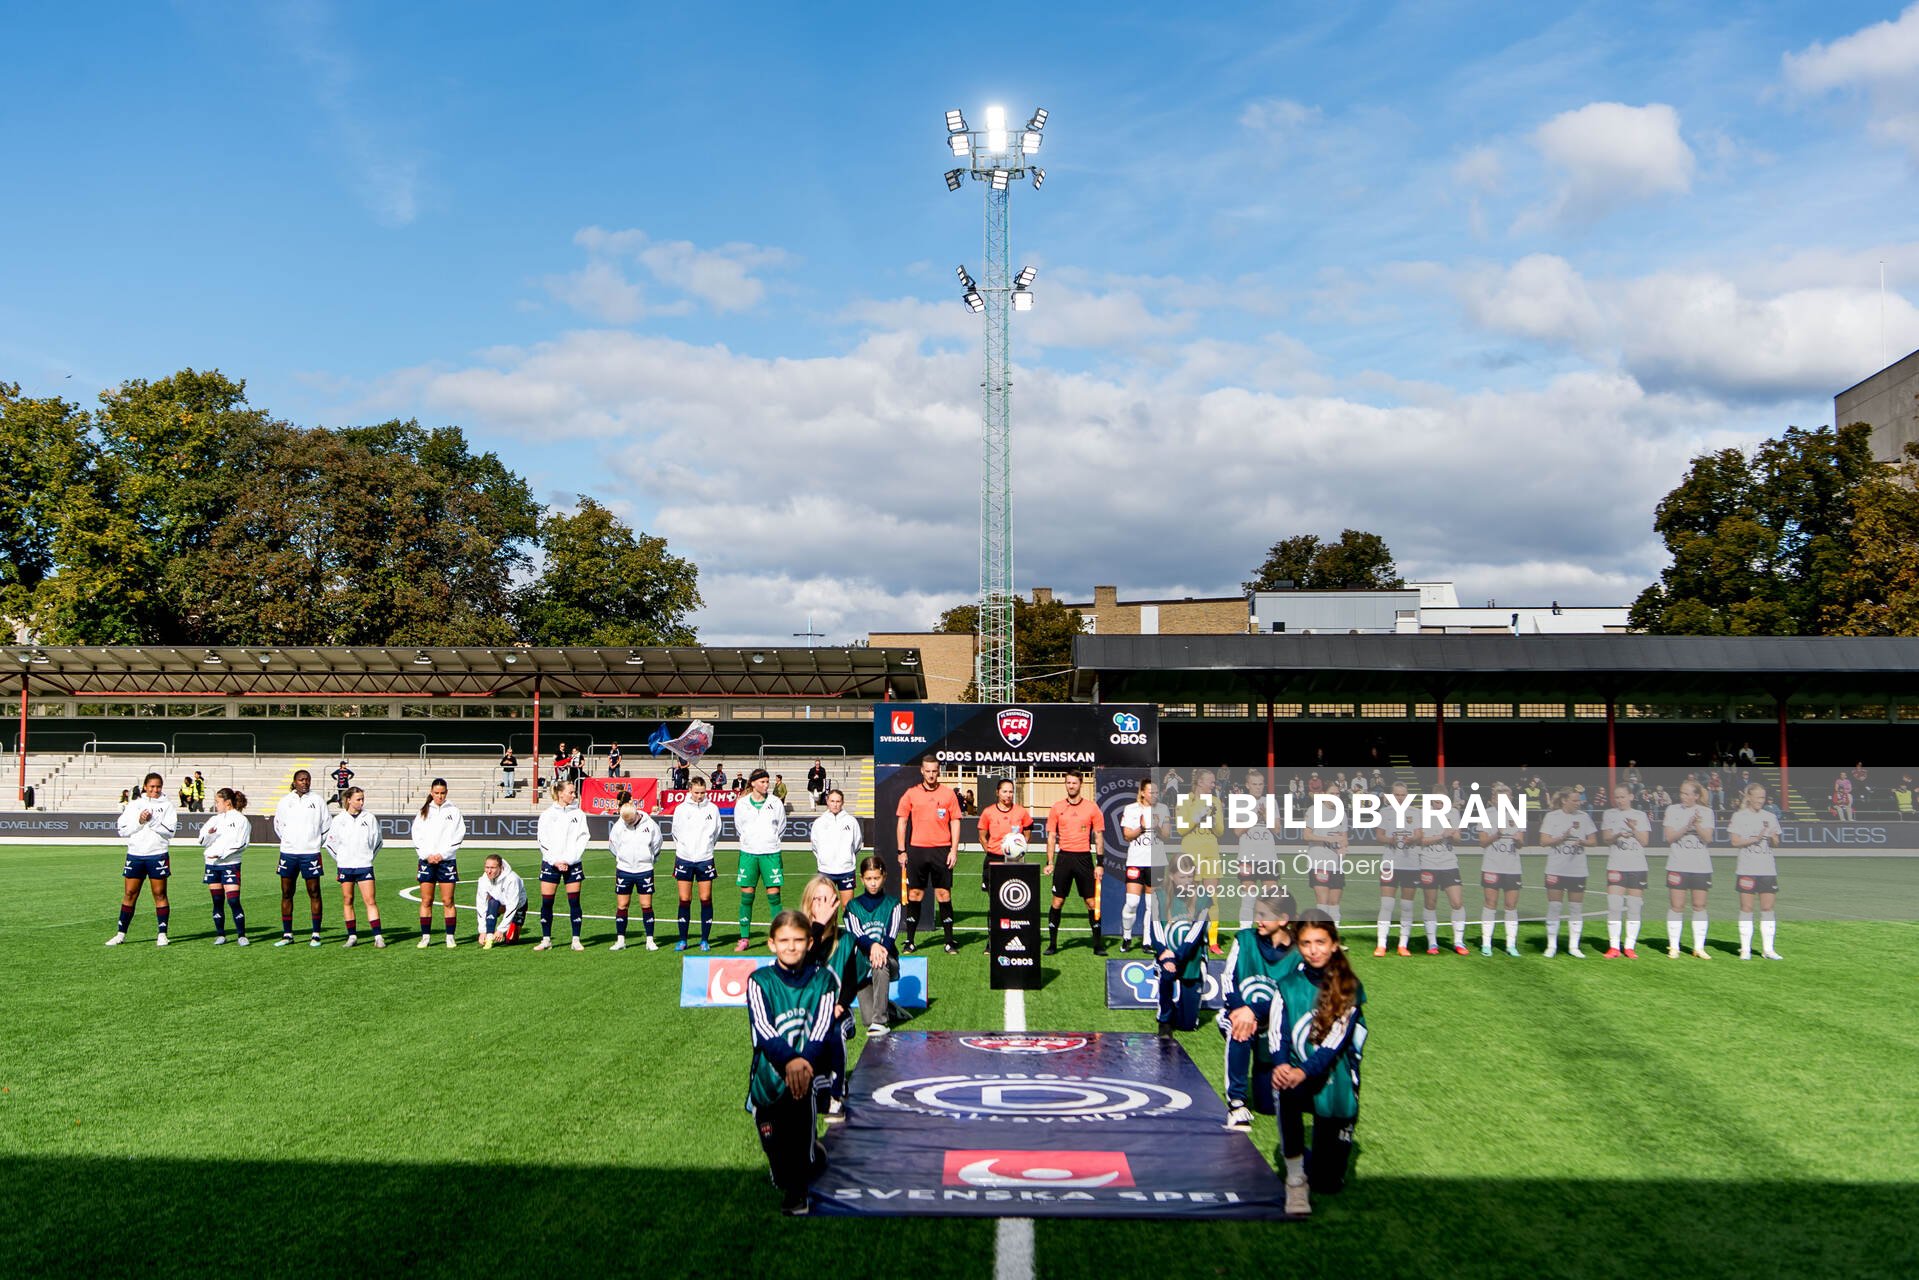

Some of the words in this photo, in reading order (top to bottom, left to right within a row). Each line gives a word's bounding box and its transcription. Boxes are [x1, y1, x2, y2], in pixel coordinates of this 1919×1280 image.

[1002, 719, 1028, 730] FCR
[880, 735, 909, 743] SVENSKA
[1110, 733, 1147, 745] OBOS
[936, 750, 972, 762] OBOS
[975, 751, 1095, 763] DAMALLSVENSKAN
[1101, 778, 1134, 795] OBOS
[1010, 957, 1033, 966] OBOS
[834, 1187, 1096, 1202] SVENSKA
